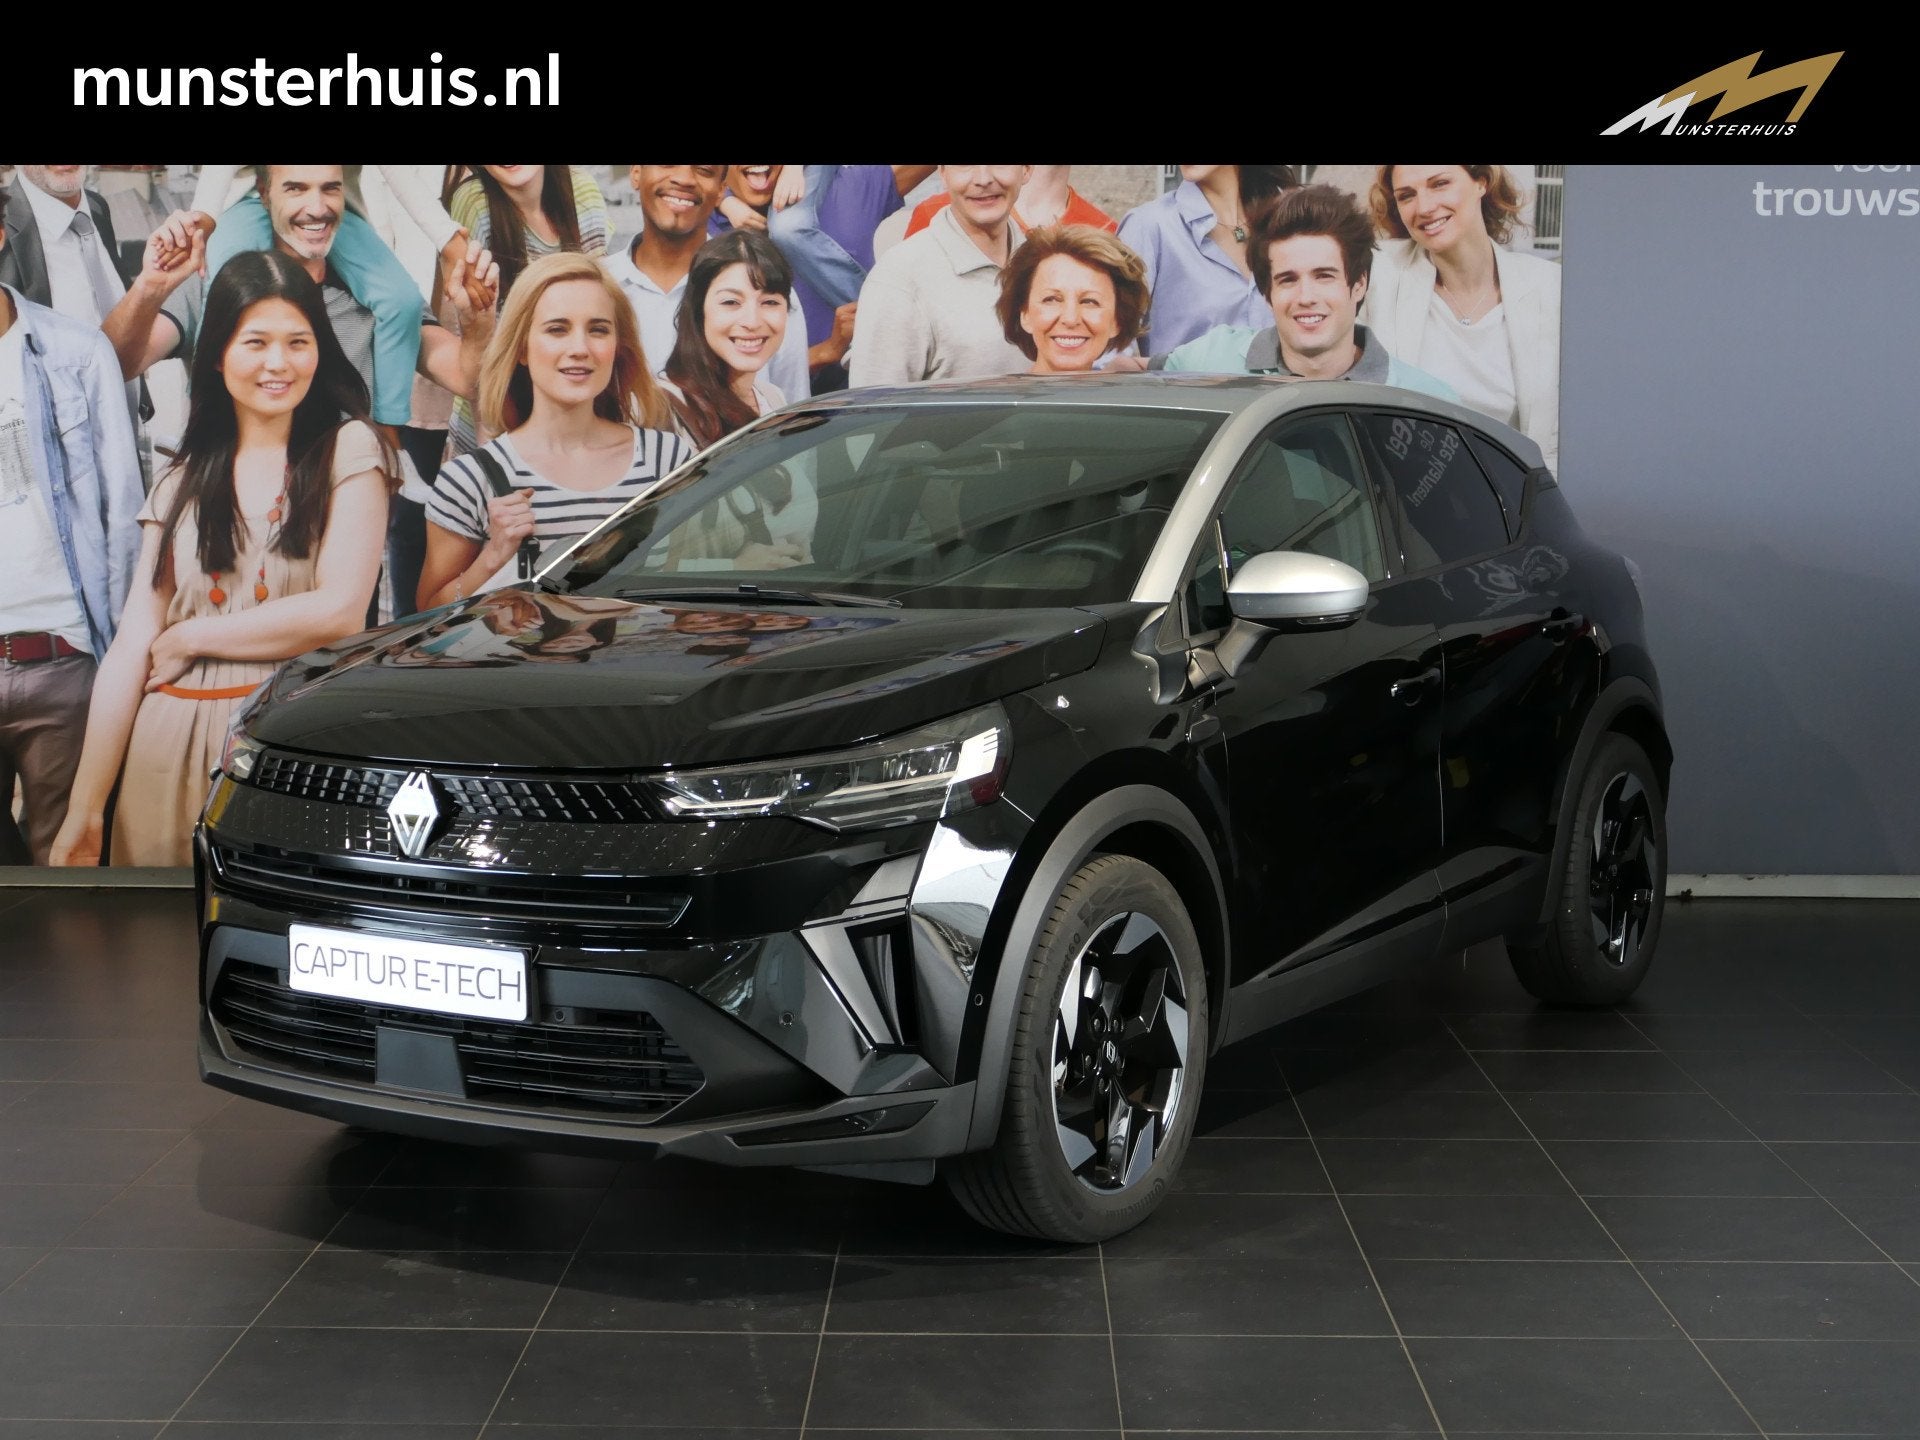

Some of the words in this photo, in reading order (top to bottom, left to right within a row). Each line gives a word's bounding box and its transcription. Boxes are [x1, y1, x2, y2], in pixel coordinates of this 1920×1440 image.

[1752, 181, 1920, 217] trouws
[294, 943, 406, 989] CAPTUR
[414, 959, 521, 1003] E-TECH
